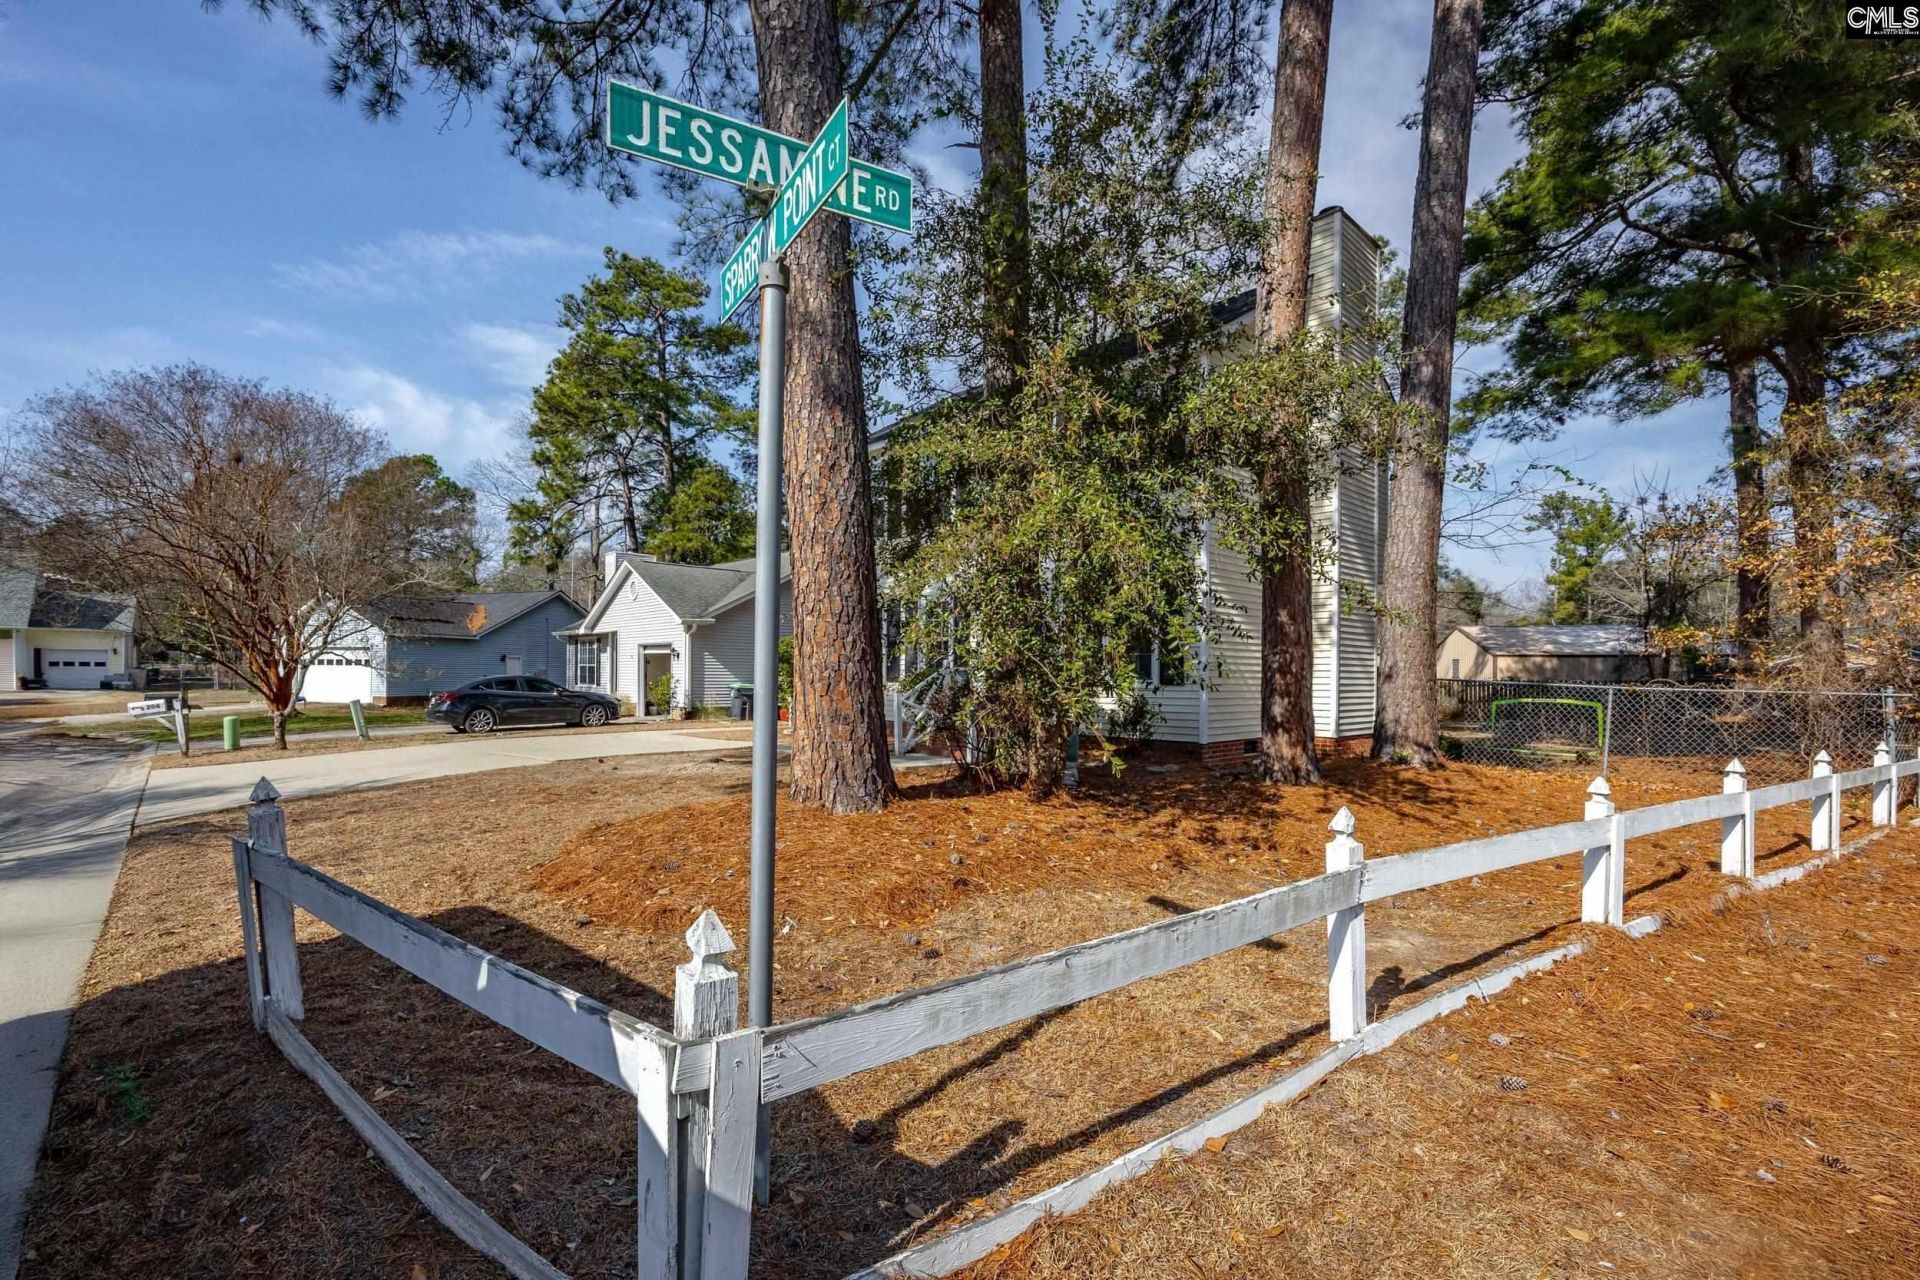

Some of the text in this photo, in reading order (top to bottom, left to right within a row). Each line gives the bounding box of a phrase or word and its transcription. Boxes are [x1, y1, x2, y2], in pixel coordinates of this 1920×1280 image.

[783, 138, 826, 240] POINT
[828, 133, 841, 172] CT
[875, 185, 900, 211] RD
